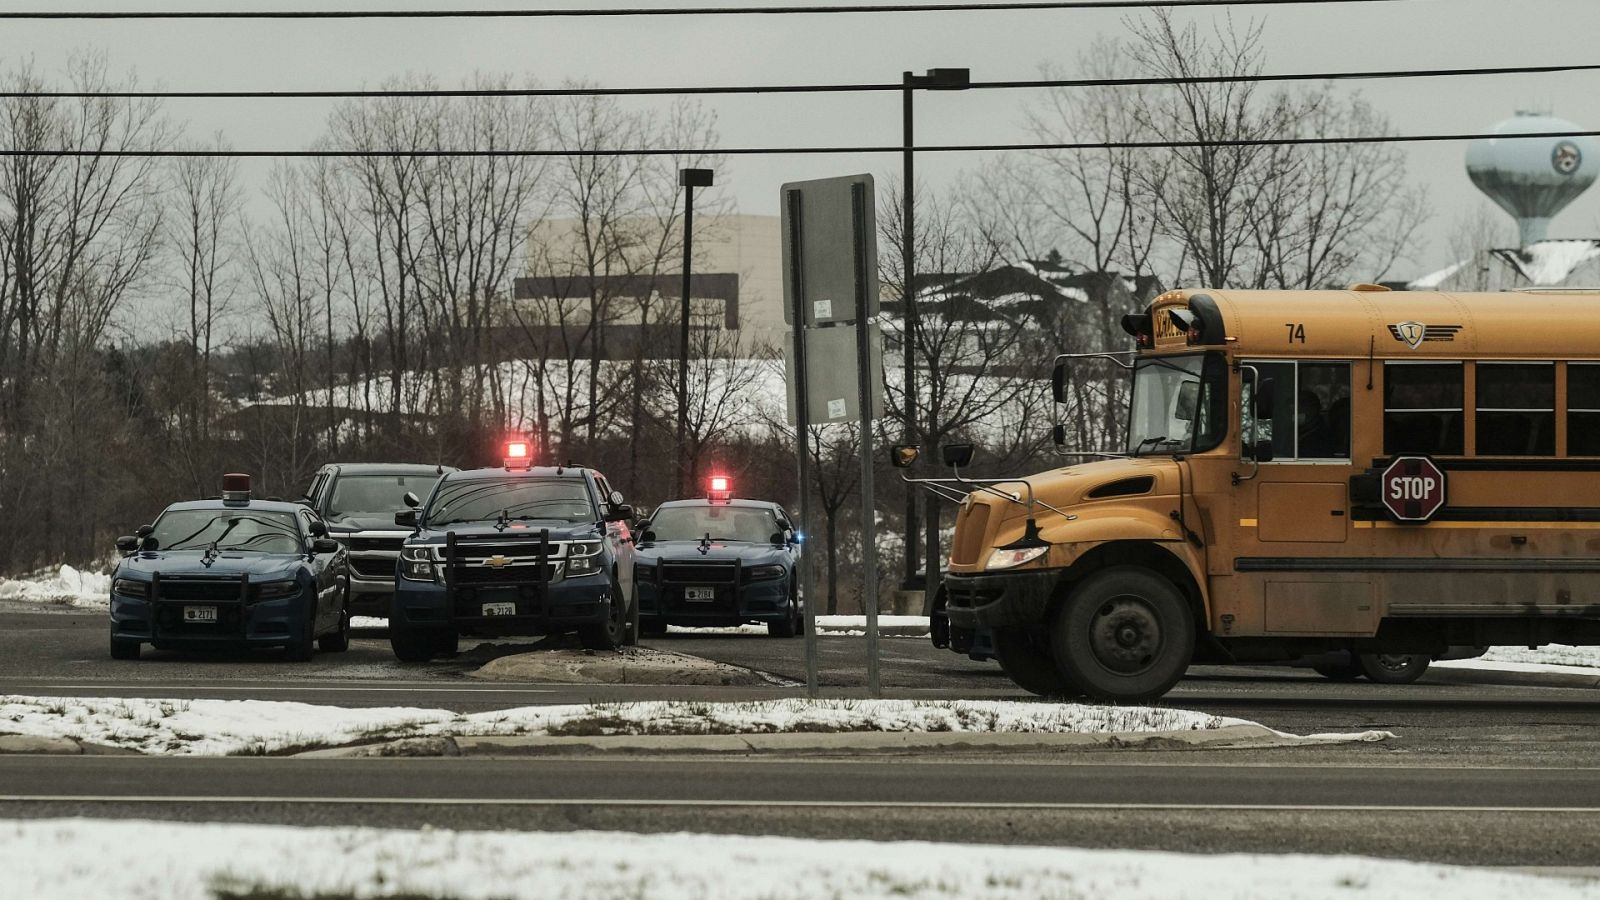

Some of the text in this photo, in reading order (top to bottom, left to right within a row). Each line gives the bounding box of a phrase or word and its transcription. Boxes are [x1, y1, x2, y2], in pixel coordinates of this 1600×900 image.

[1285, 323, 1306, 344] 74
[1390, 477, 1436, 500] STOP
[198, 610, 213, 619] 2171
